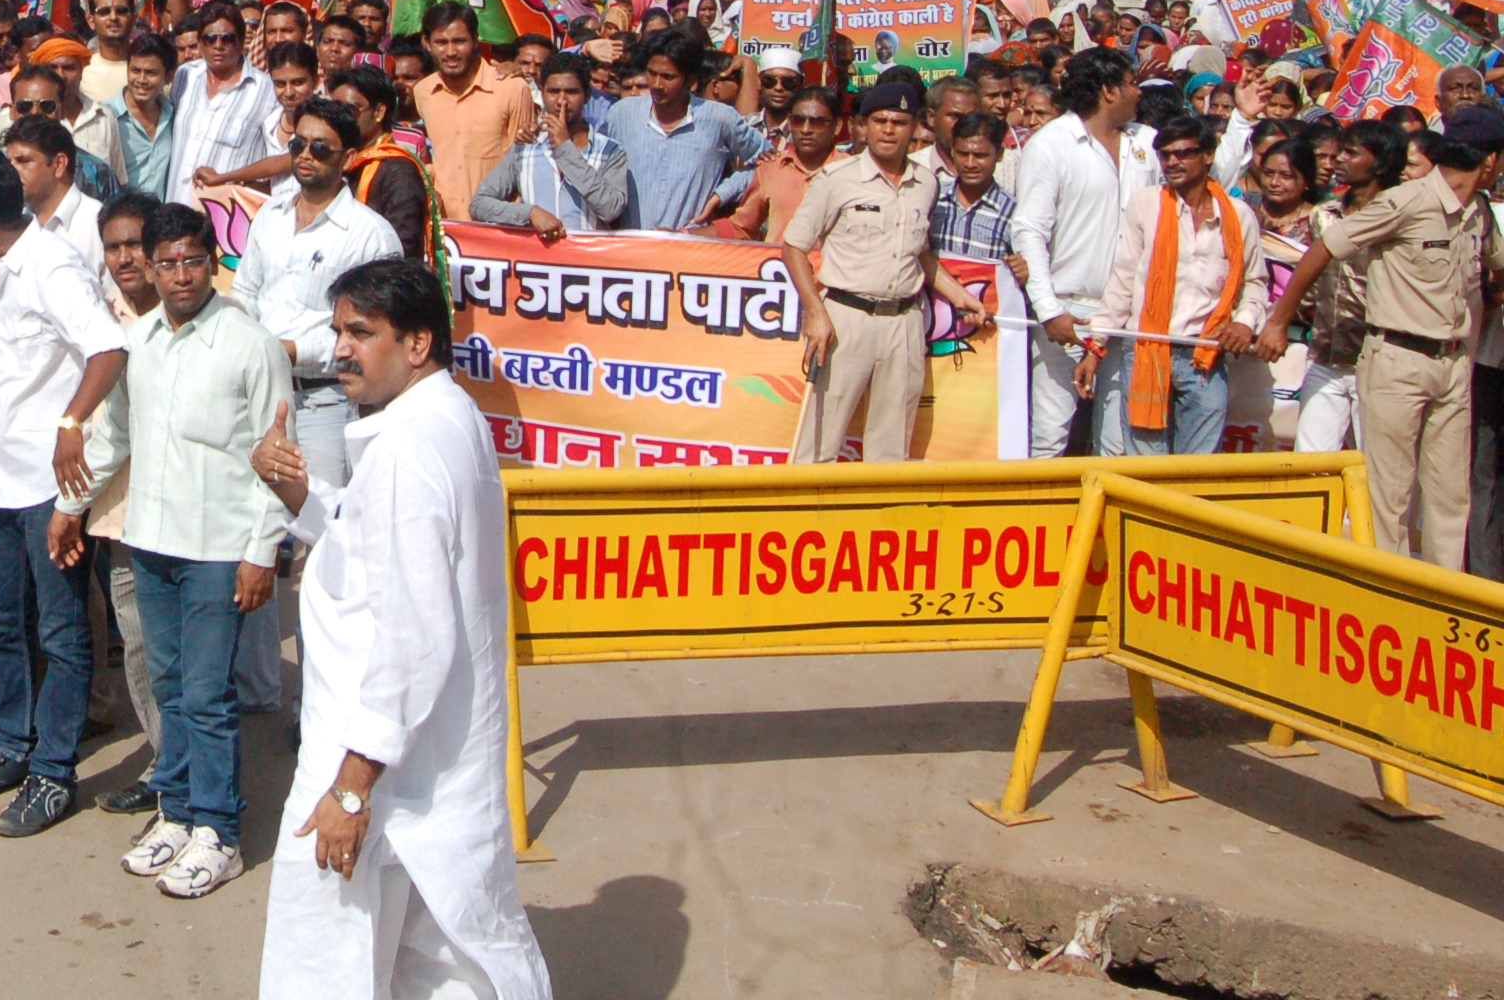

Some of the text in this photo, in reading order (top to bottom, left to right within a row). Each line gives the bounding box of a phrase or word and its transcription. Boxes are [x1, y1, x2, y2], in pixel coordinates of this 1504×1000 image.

[848, 2, 955, 28] कांग्रेस काली है
[1238, 0, 1294, 30] पूरी कांग्रेस
[915, 38, 953, 58] चोर
[515, 259, 674, 330] जनता
[500, 343, 726, 408] बस्ती मण्डल
[516, 526, 937, 602] CHHATTISGARH
[1128, 549, 1504, 731] CHHATTISGARH
